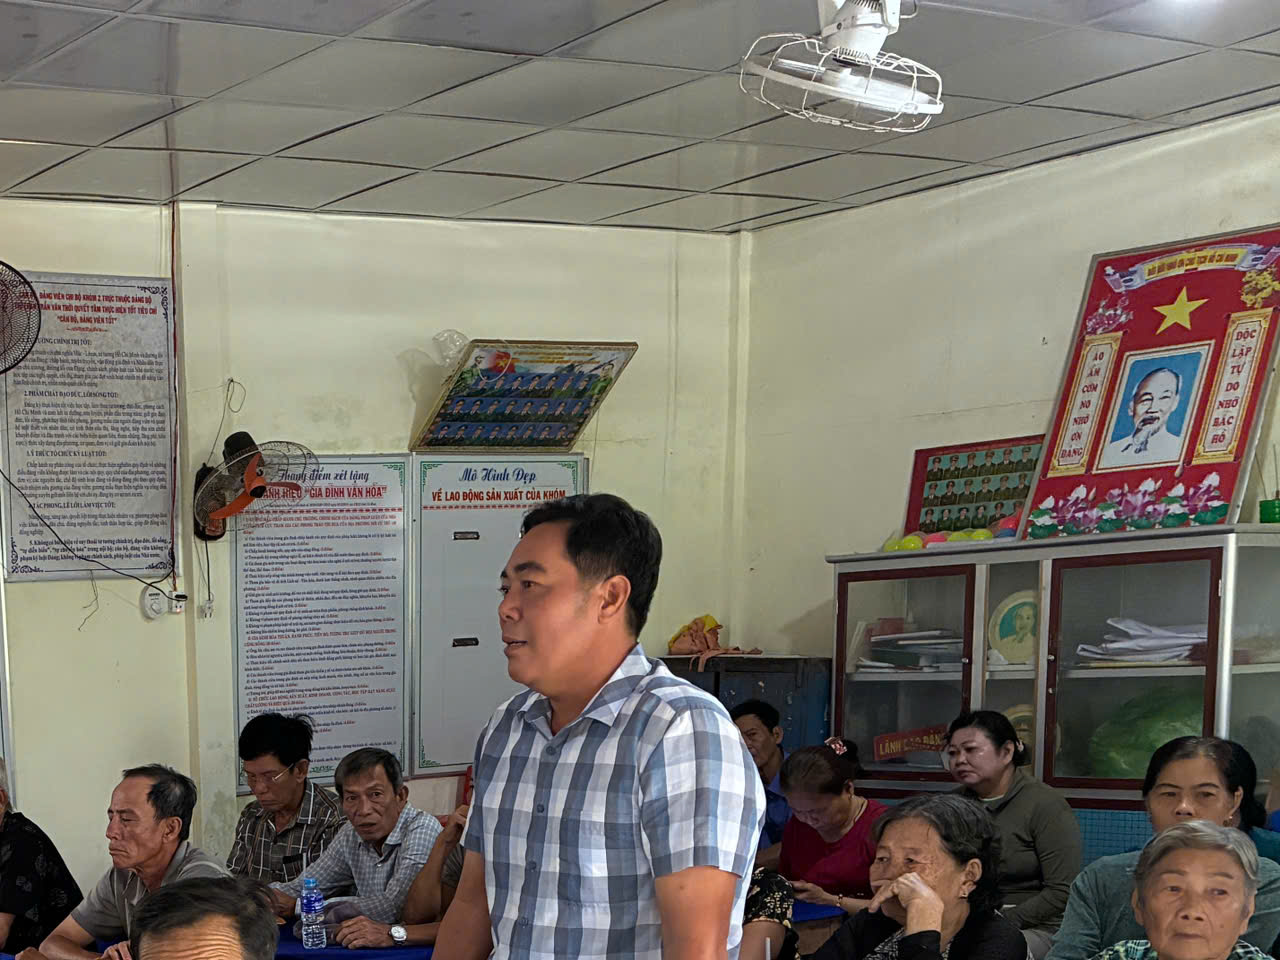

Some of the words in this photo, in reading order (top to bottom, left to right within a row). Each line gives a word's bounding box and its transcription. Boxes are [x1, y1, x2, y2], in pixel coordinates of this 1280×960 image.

[1236, 328, 1256, 341] ĐỘC
[1232, 345, 1252, 358] LẬP
[1225, 381, 1240, 392] DO
[334, 470, 348, 480] xét
[350, 471, 369, 483] tặng
[458, 467, 477, 482] Mô
[512, 467, 537, 484] Đẹp
[325, 483, 345, 498] ĐÌNH
[347, 484, 363, 498] VĂN
[432, 488, 443, 501] VỀ
[445, 491, 460, 501] LAO
[463, 489, 484, 502] ĐỘNG
[486, 488, 502, 501] SẢN
[503, 487, 524, 501] XUẤT
[526, 487, 541, 500] CỦA
[543, 488, 566, 500] KHÓM
